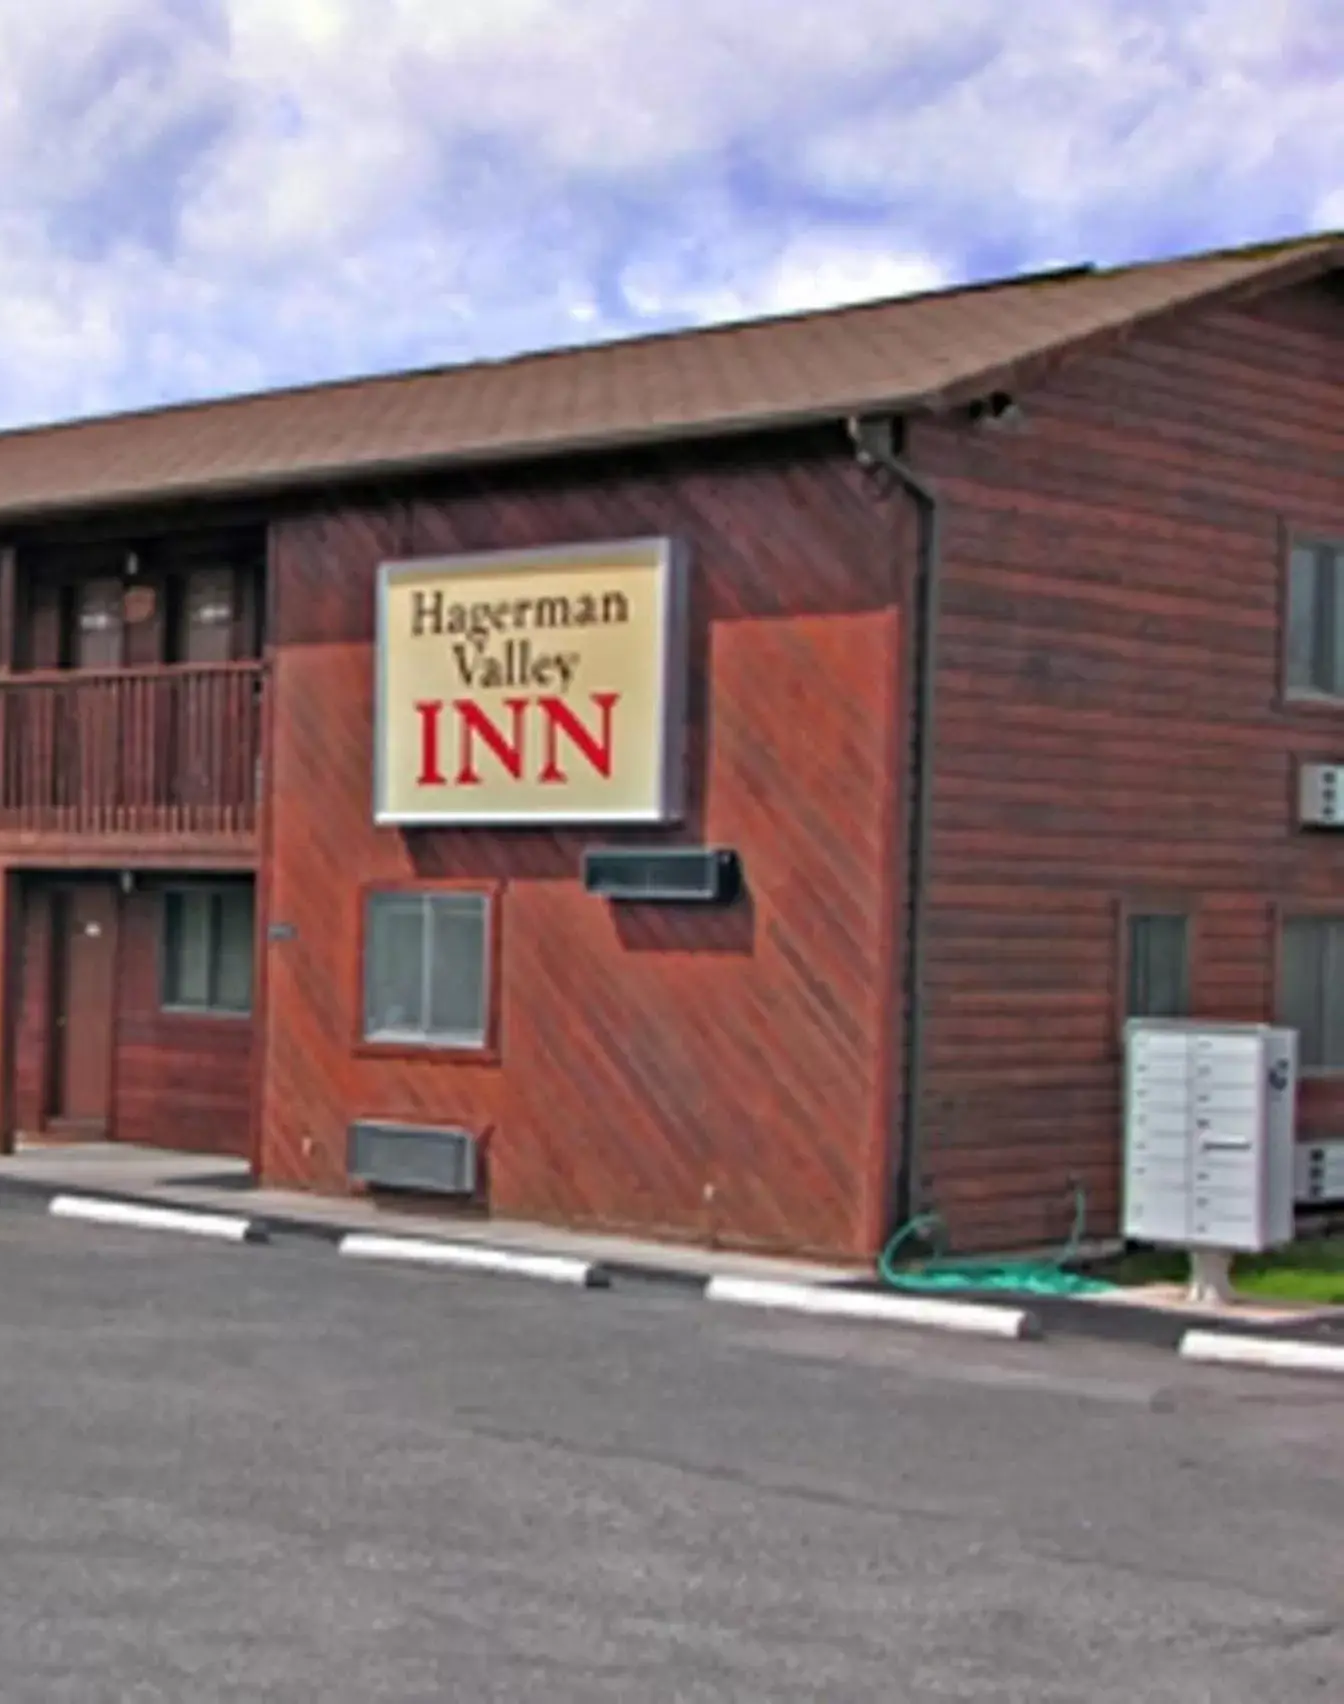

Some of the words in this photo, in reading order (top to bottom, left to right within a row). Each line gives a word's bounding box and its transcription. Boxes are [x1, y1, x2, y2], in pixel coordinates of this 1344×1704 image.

[411, 590, 630, 652] Hagerman
[452, 638, 579, 691] Valley
[413, 692, 621, 786] INN
